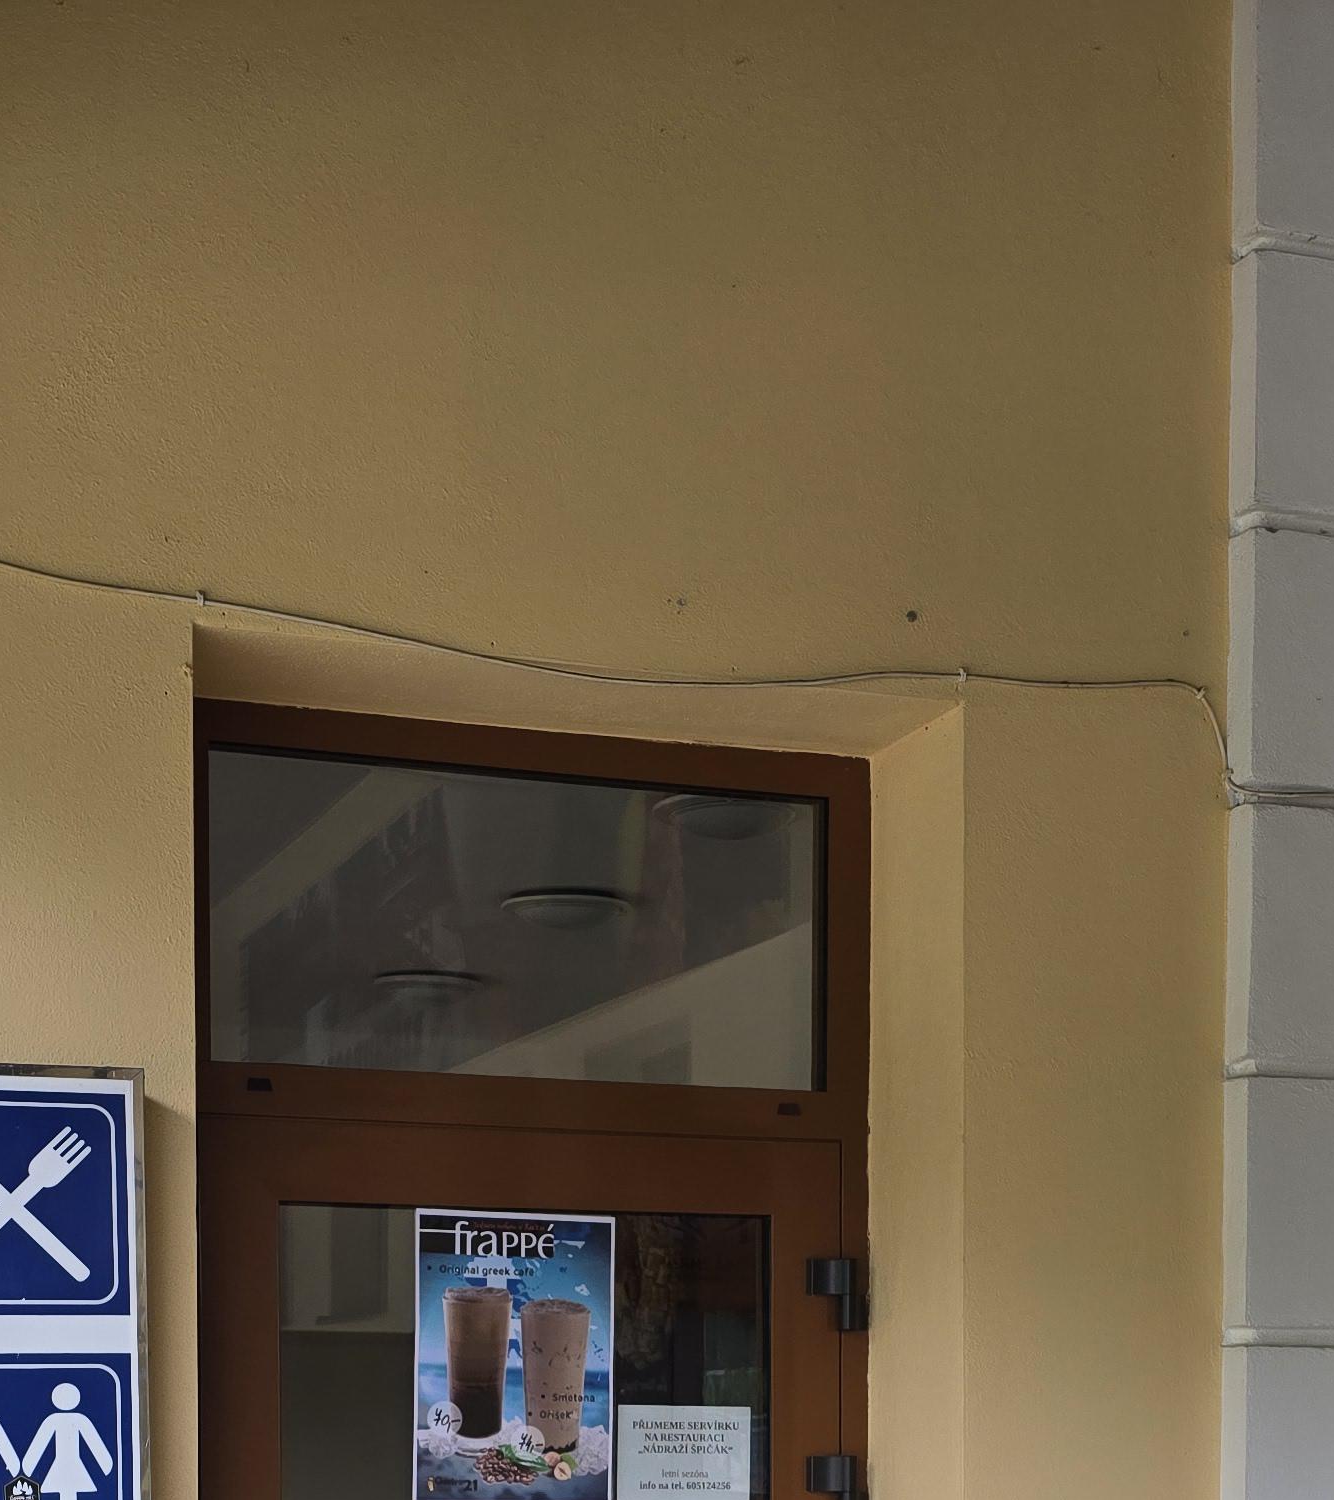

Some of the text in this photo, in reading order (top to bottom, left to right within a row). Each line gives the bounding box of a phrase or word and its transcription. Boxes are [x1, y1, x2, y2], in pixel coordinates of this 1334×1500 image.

[454, 1220, 555, 1259] frappé
[438, 1264, 479, 1277] Original
[481, 1266, 510, 1277] greek
[552, 1393, 596, 1403] Smetana
[632, 1419, 739, 1431] PŘIJMEME SERVÍRKU
[644, 1433, 725, 1443] NA RESTAURACI
[661, 1468, 709, 1479] letní sezóna
[639, 1480, 657, 1490] info
[671, 1481, 684, 1490] tel.
[686, 1481, 732, 1490] 605124256
